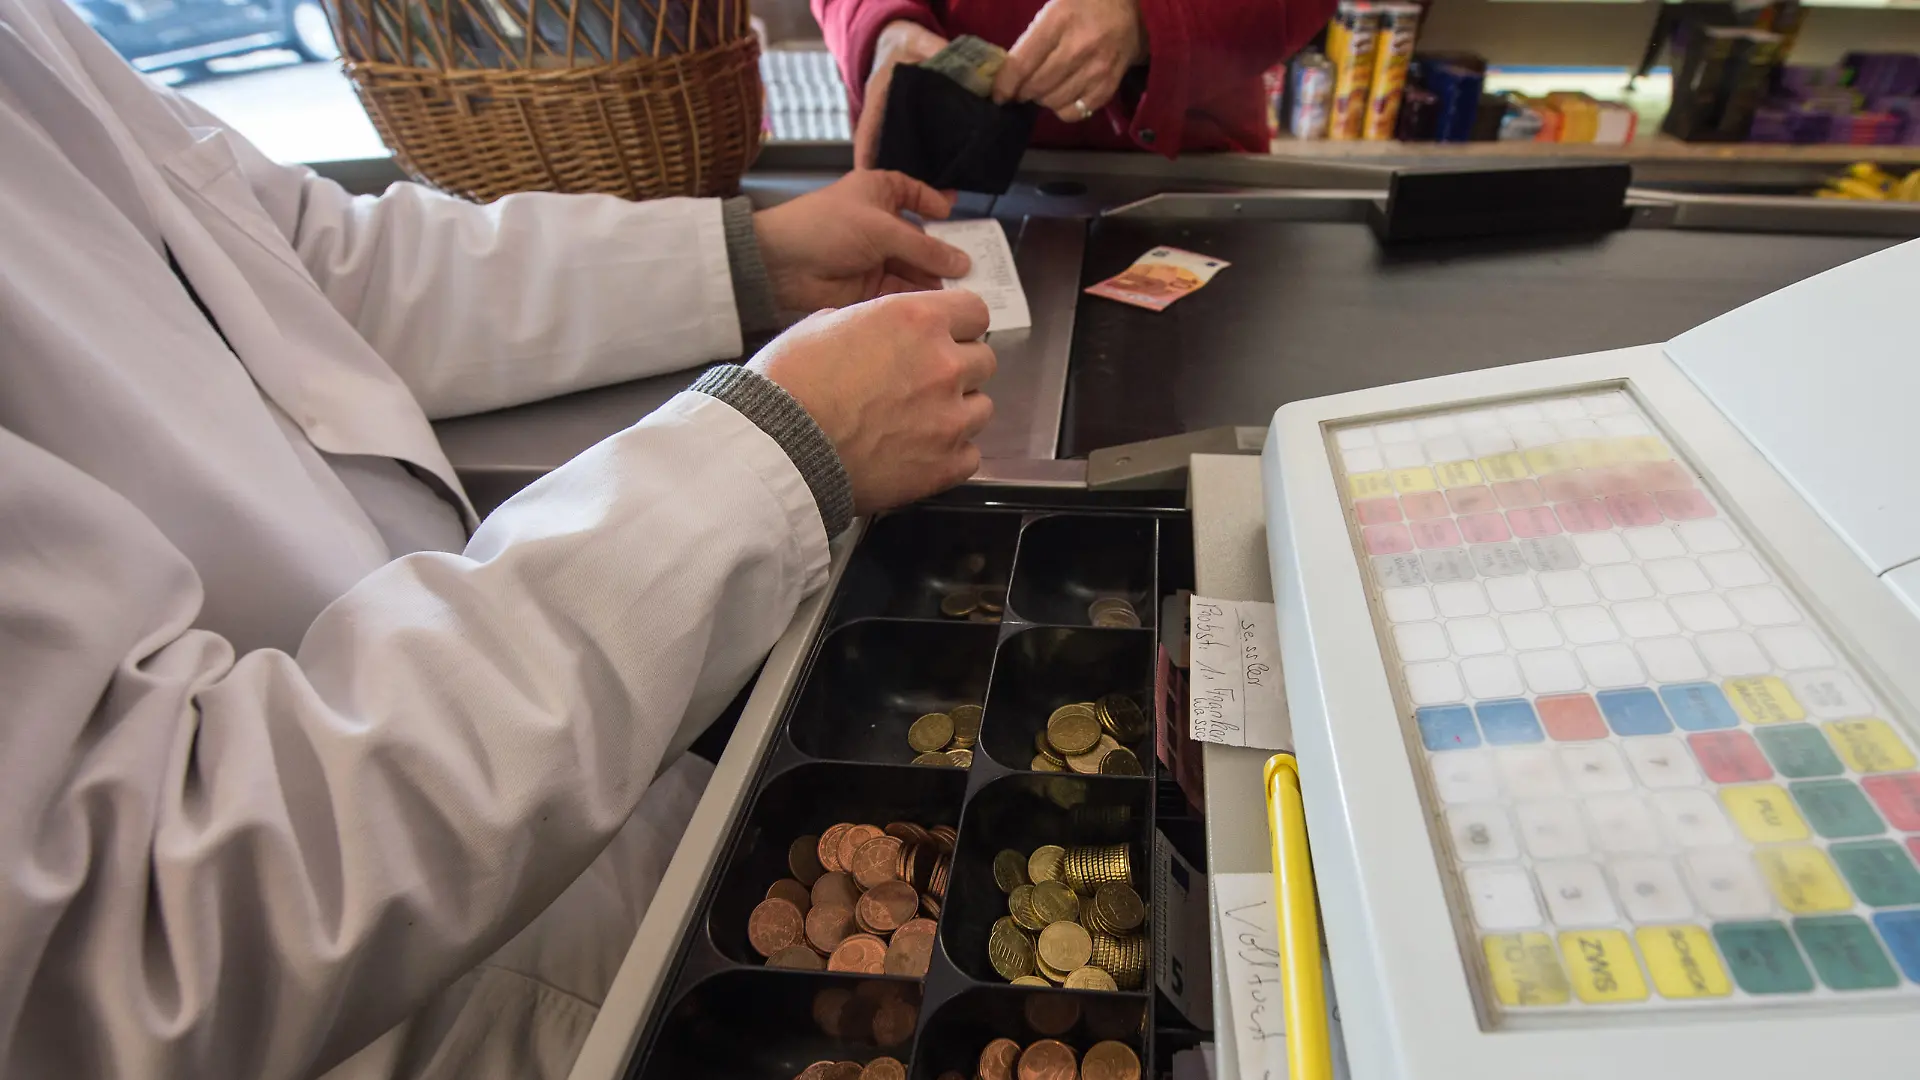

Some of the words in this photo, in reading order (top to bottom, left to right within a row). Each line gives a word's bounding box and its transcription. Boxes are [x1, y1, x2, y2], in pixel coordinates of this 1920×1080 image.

[1205, 687, 1240, 743] Franken
[1754, 798, 1783, 826] PLU
[1559, 885, 1582, 901] 3
[1171, 955, 1184, 998] 5
[1501, 931, 1542, 1005] TOTAL
[1577, 936, 1618, 993] ZWS
[1667, 928, 1709, 992] SCHECK
